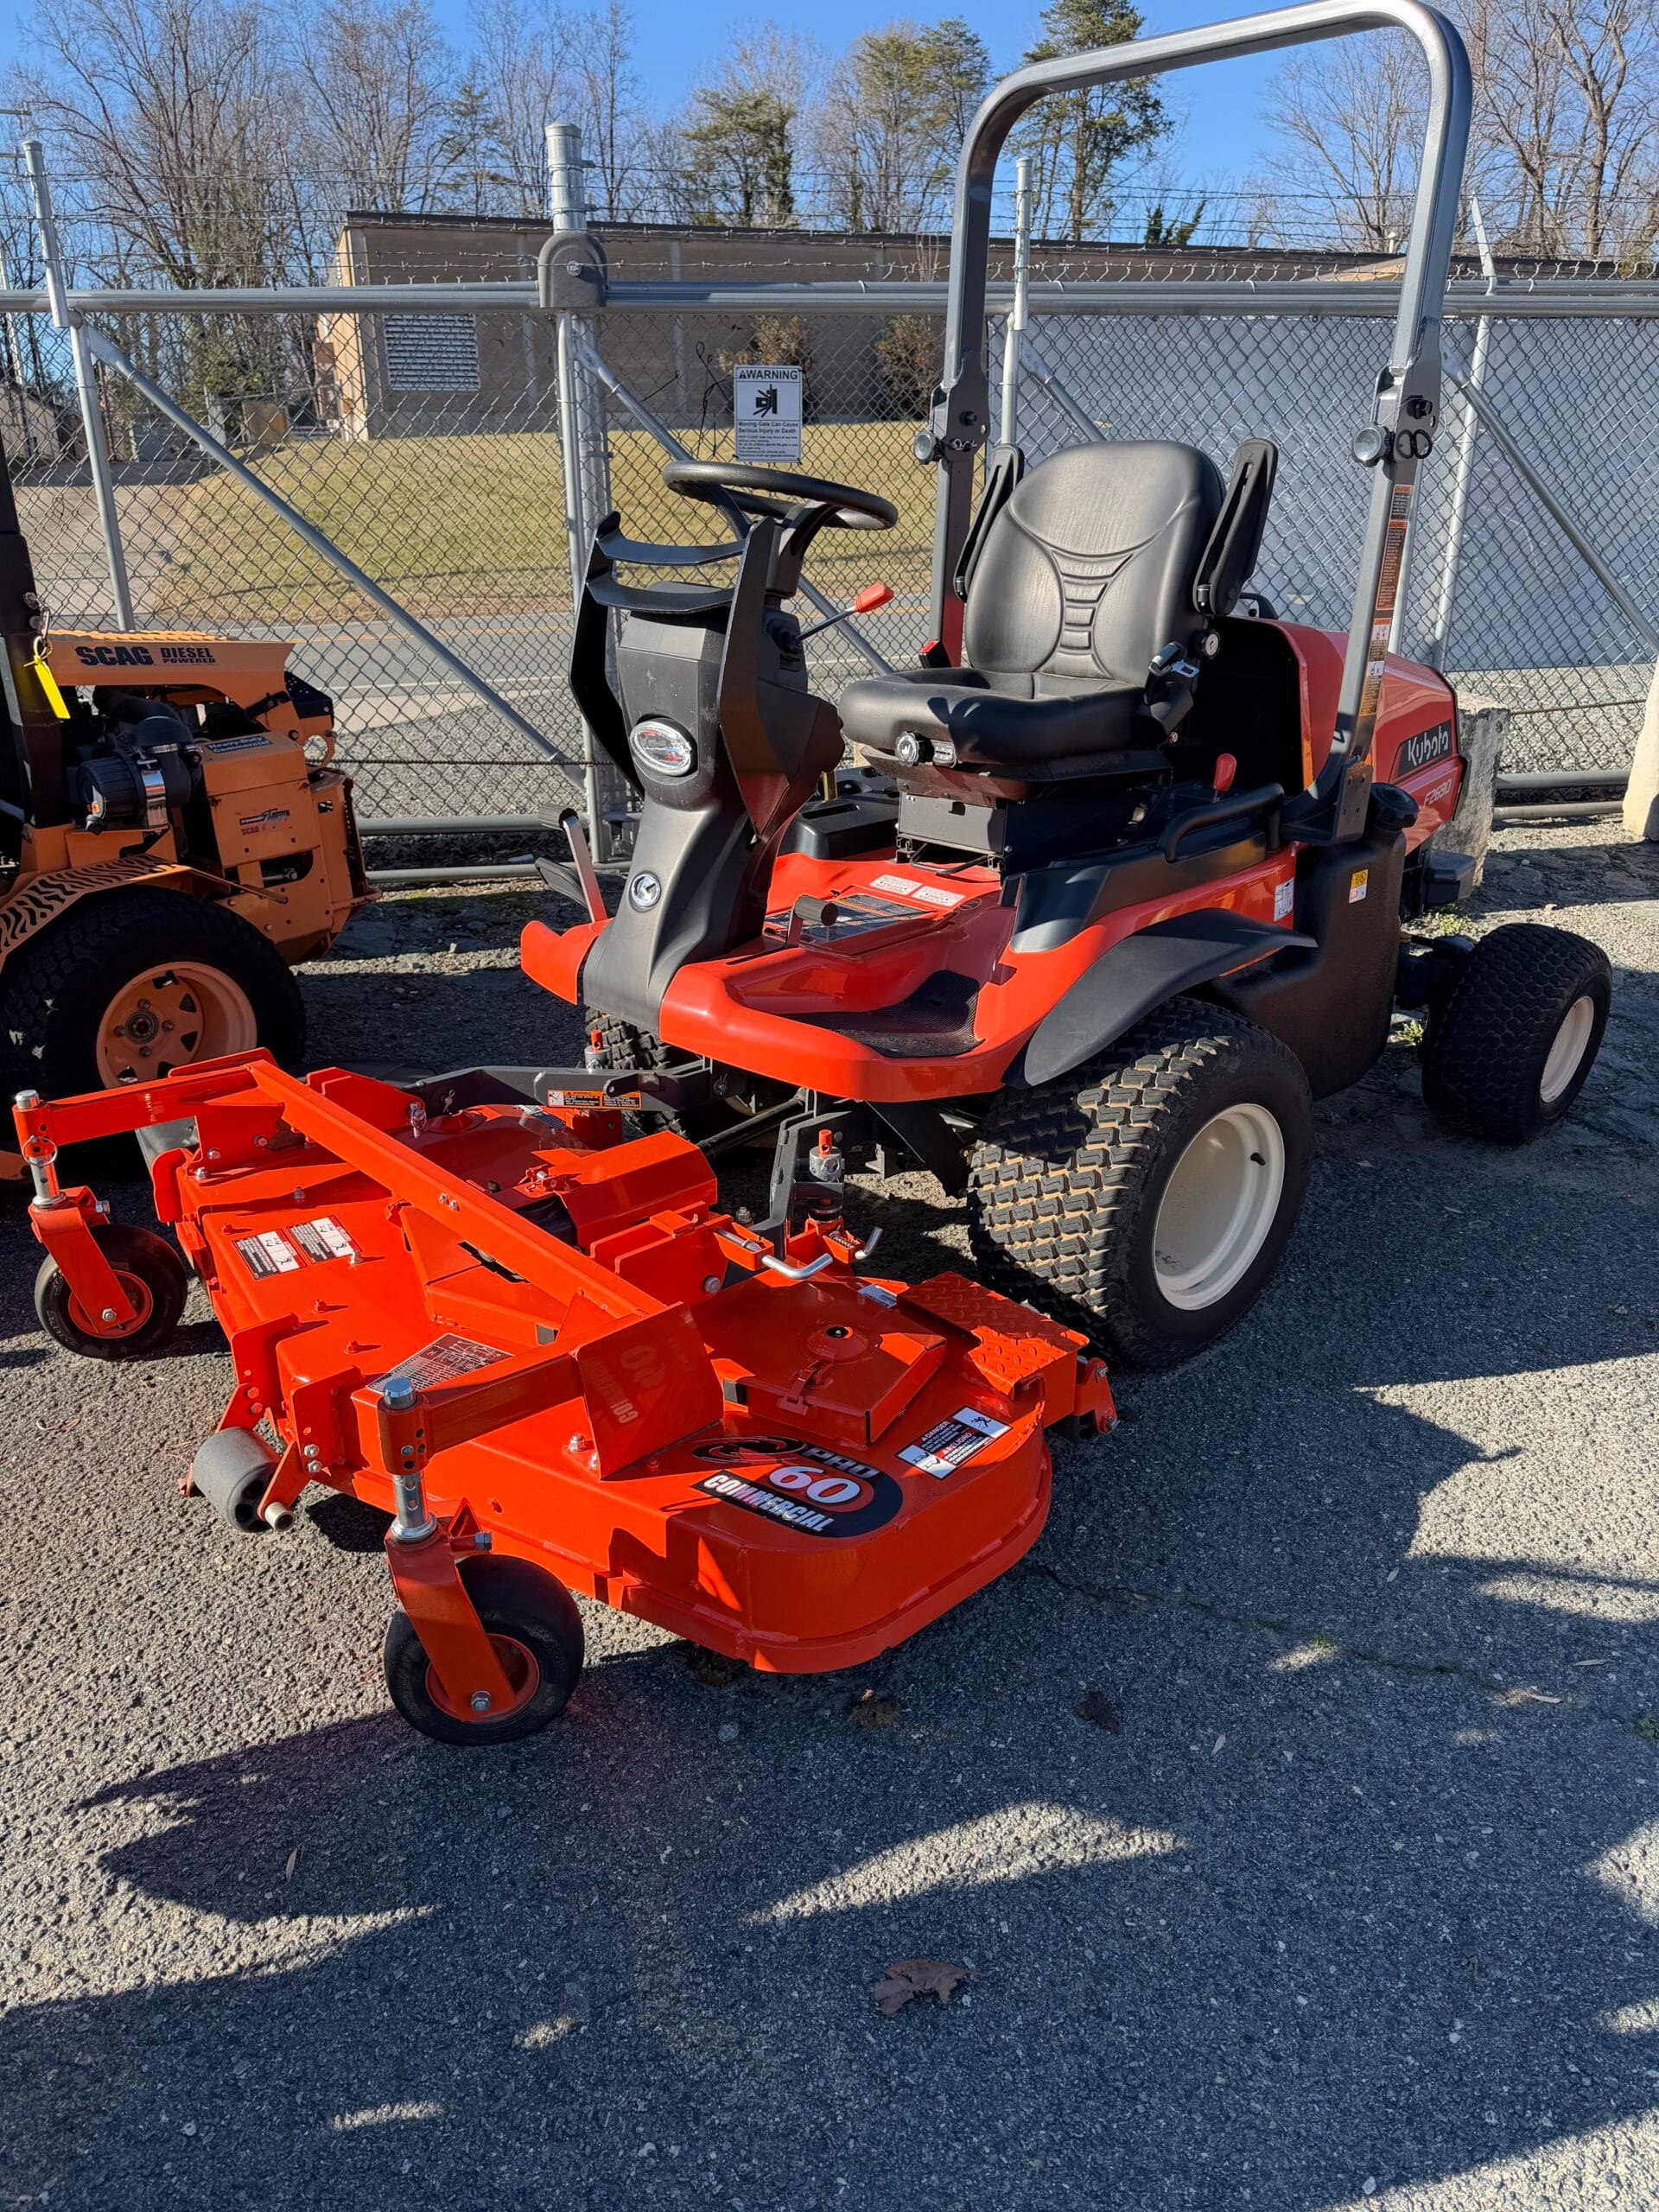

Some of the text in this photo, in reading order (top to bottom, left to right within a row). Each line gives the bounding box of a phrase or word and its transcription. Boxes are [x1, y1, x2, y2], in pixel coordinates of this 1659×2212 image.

[747, 370, 798, 380] WARNING
[74, 646, 213, 665] SCAG DIESEL
[213, 740, 270, 753] Commercial
[1408, 725, 1449, 766] Kubota
[927, 1421, 950, 1439] DANGER
[803, 1446, 880, 1479] PRO
[769, 1465, 861, 1503] 60
[703, 1474, 835, 1532] COMMERCIAL
